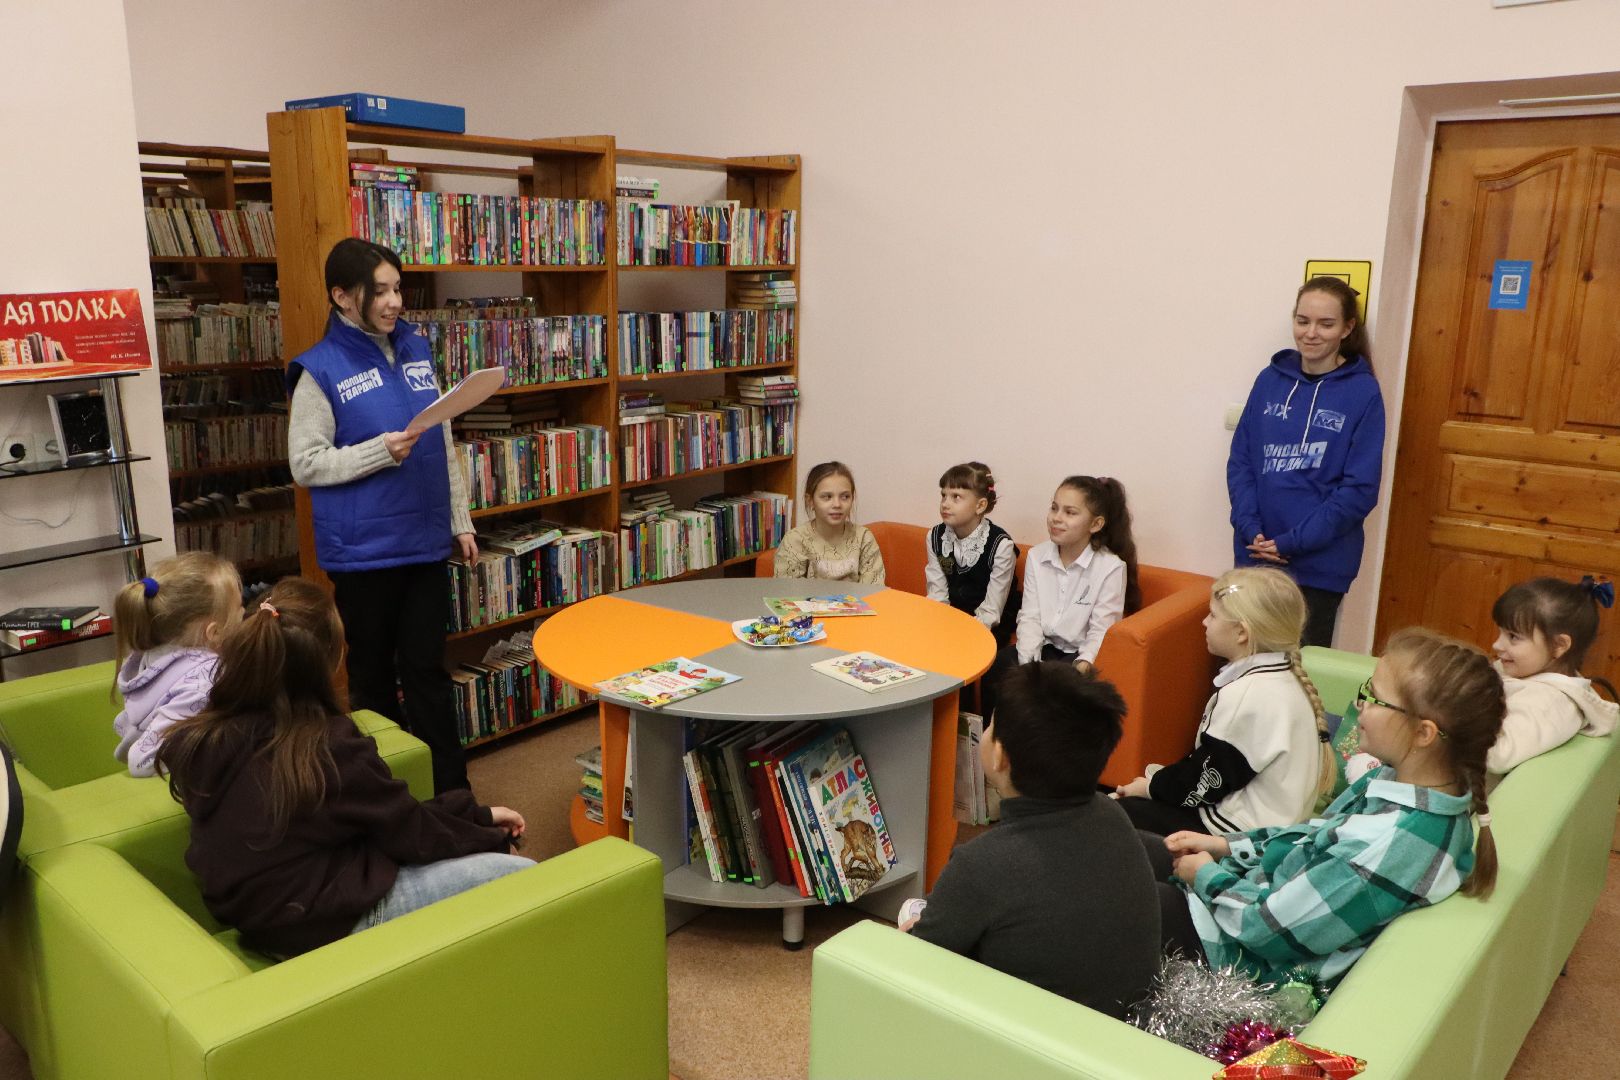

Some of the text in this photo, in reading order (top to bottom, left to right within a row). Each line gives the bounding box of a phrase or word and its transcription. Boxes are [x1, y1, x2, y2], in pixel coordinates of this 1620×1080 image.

[4, 297, 126, 326] АЯ ПОЛКА
[821, 758, 867, 806] АТЛАС
[861, 777, 898, 870] ЖИВОТНЫХ
